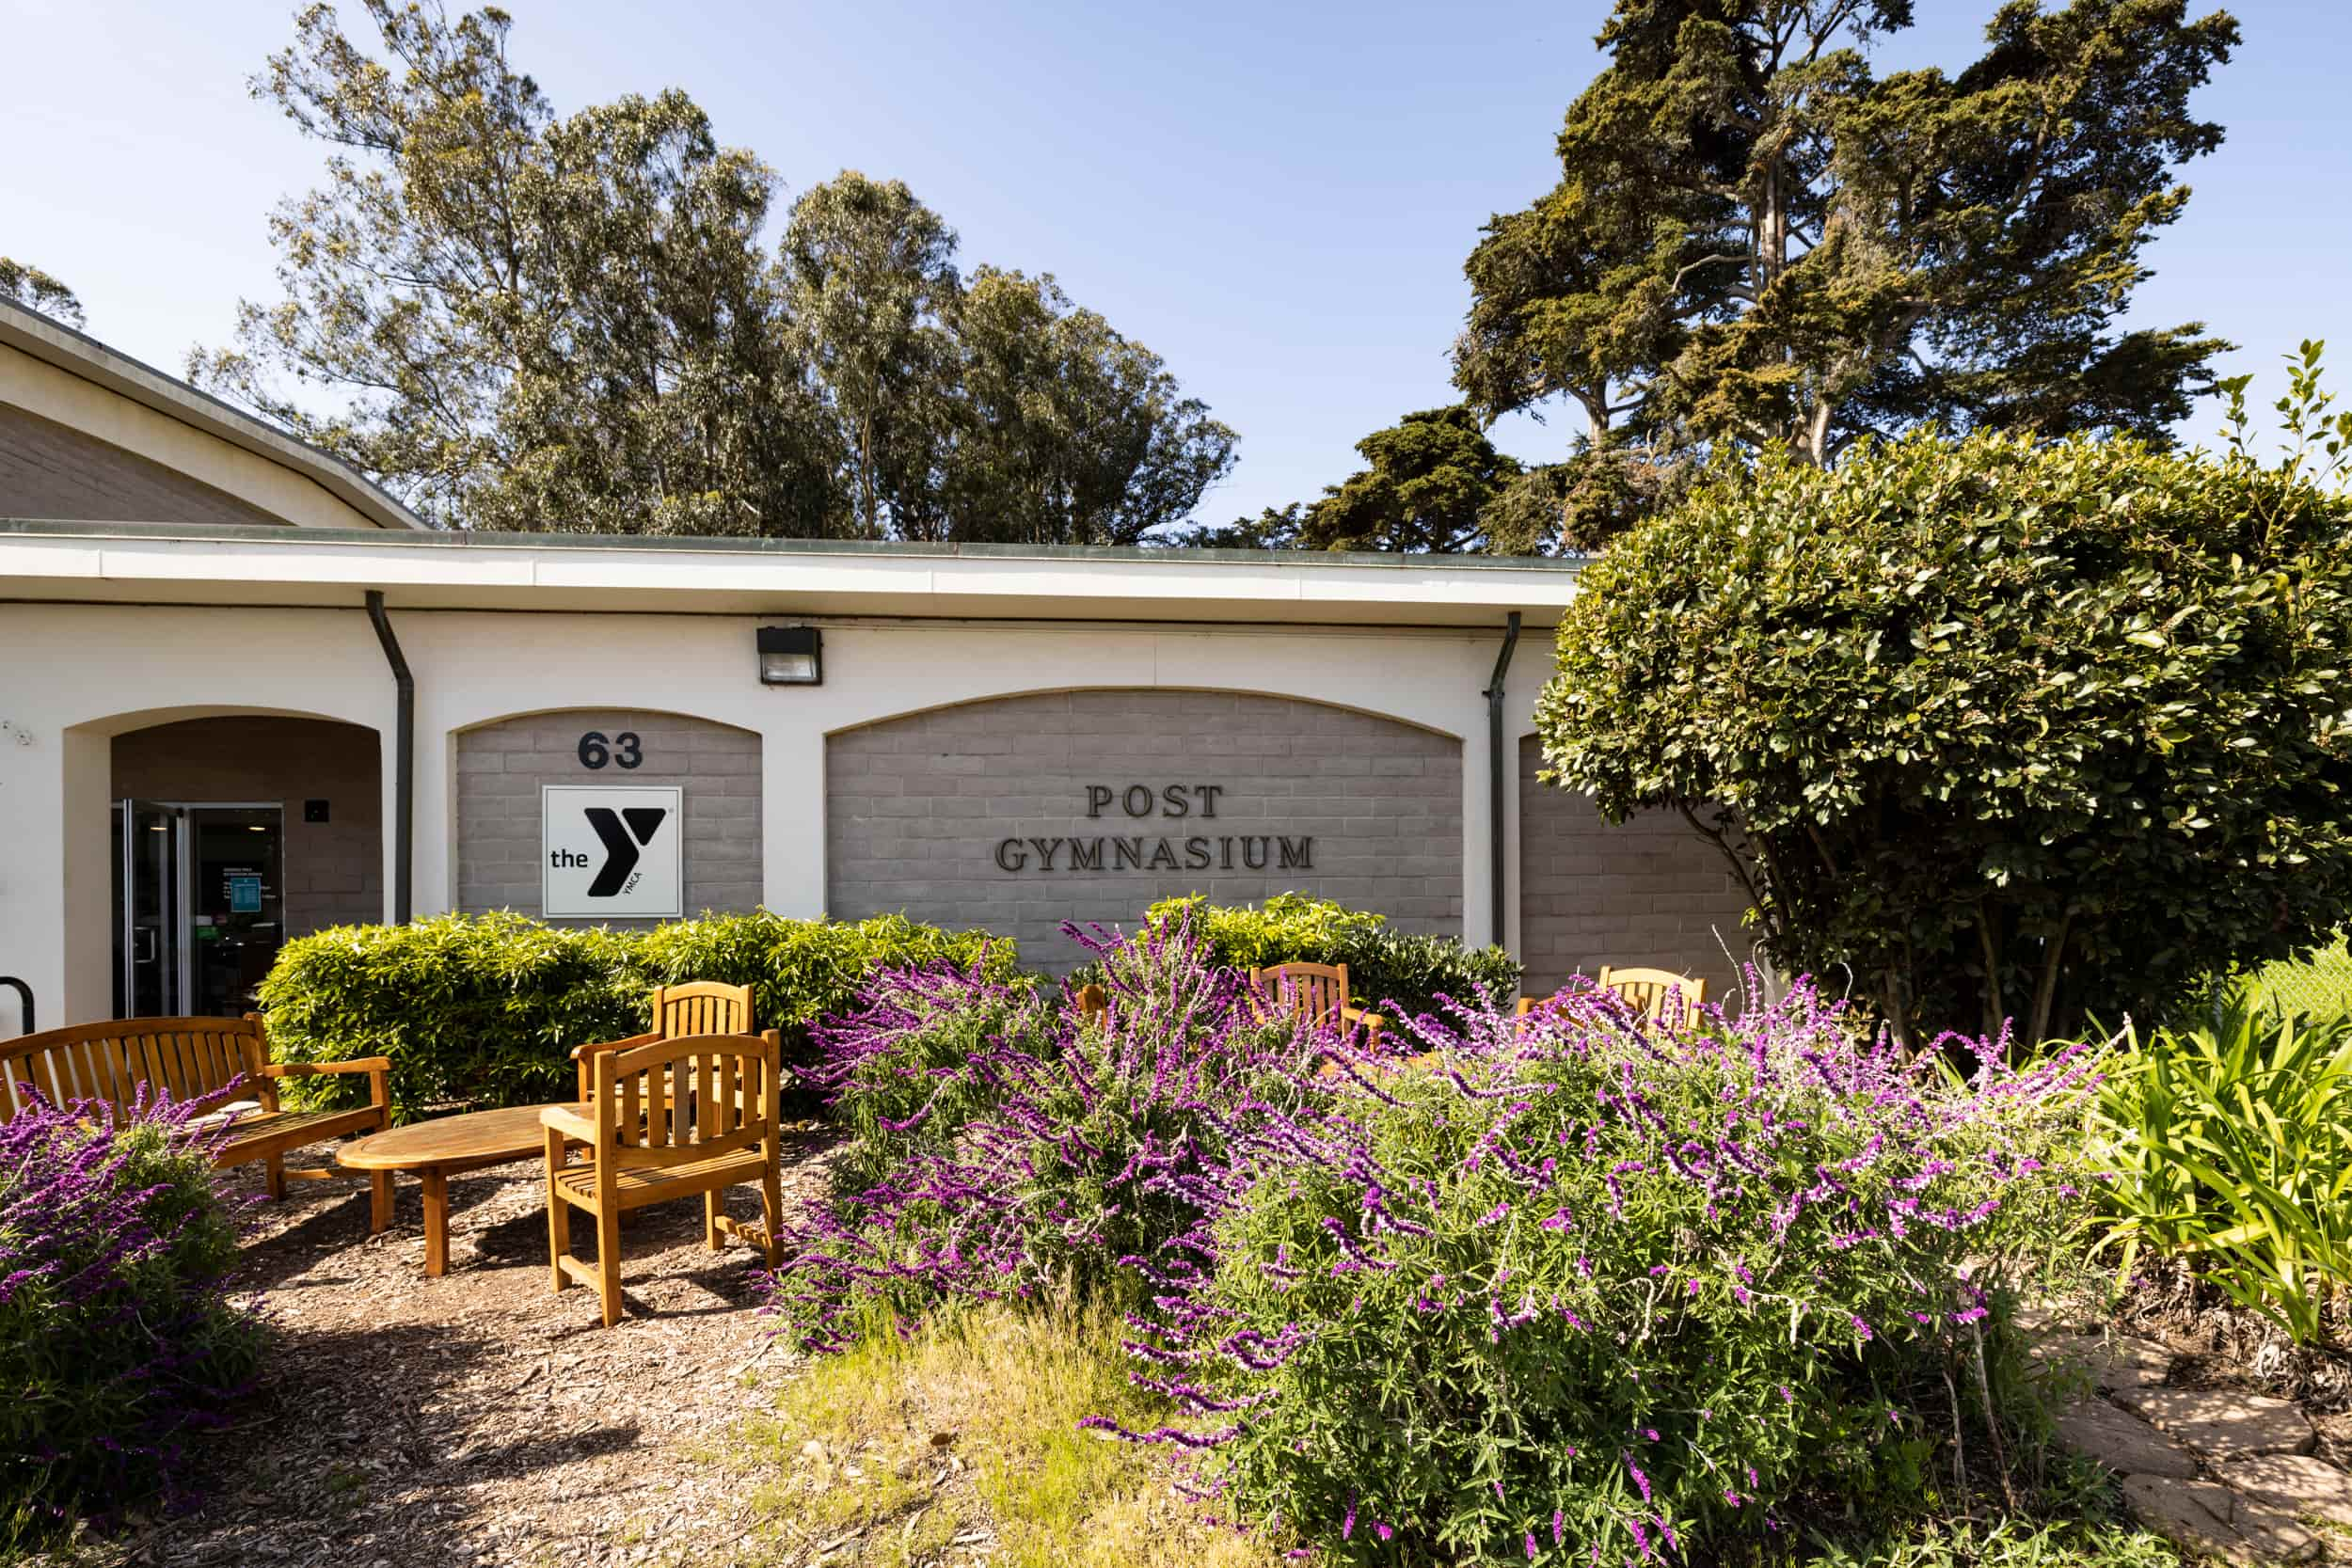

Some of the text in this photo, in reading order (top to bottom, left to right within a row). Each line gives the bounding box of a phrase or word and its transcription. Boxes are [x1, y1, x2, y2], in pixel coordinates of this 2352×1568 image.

[578, 731, 644, 769] 63
[1085, 784, 1223, 818] POST
[550, 848, 588, 868] the
[993, 835, 1314, 872] GYMNASIUM
[622, 872, 644, 895] YMCA
